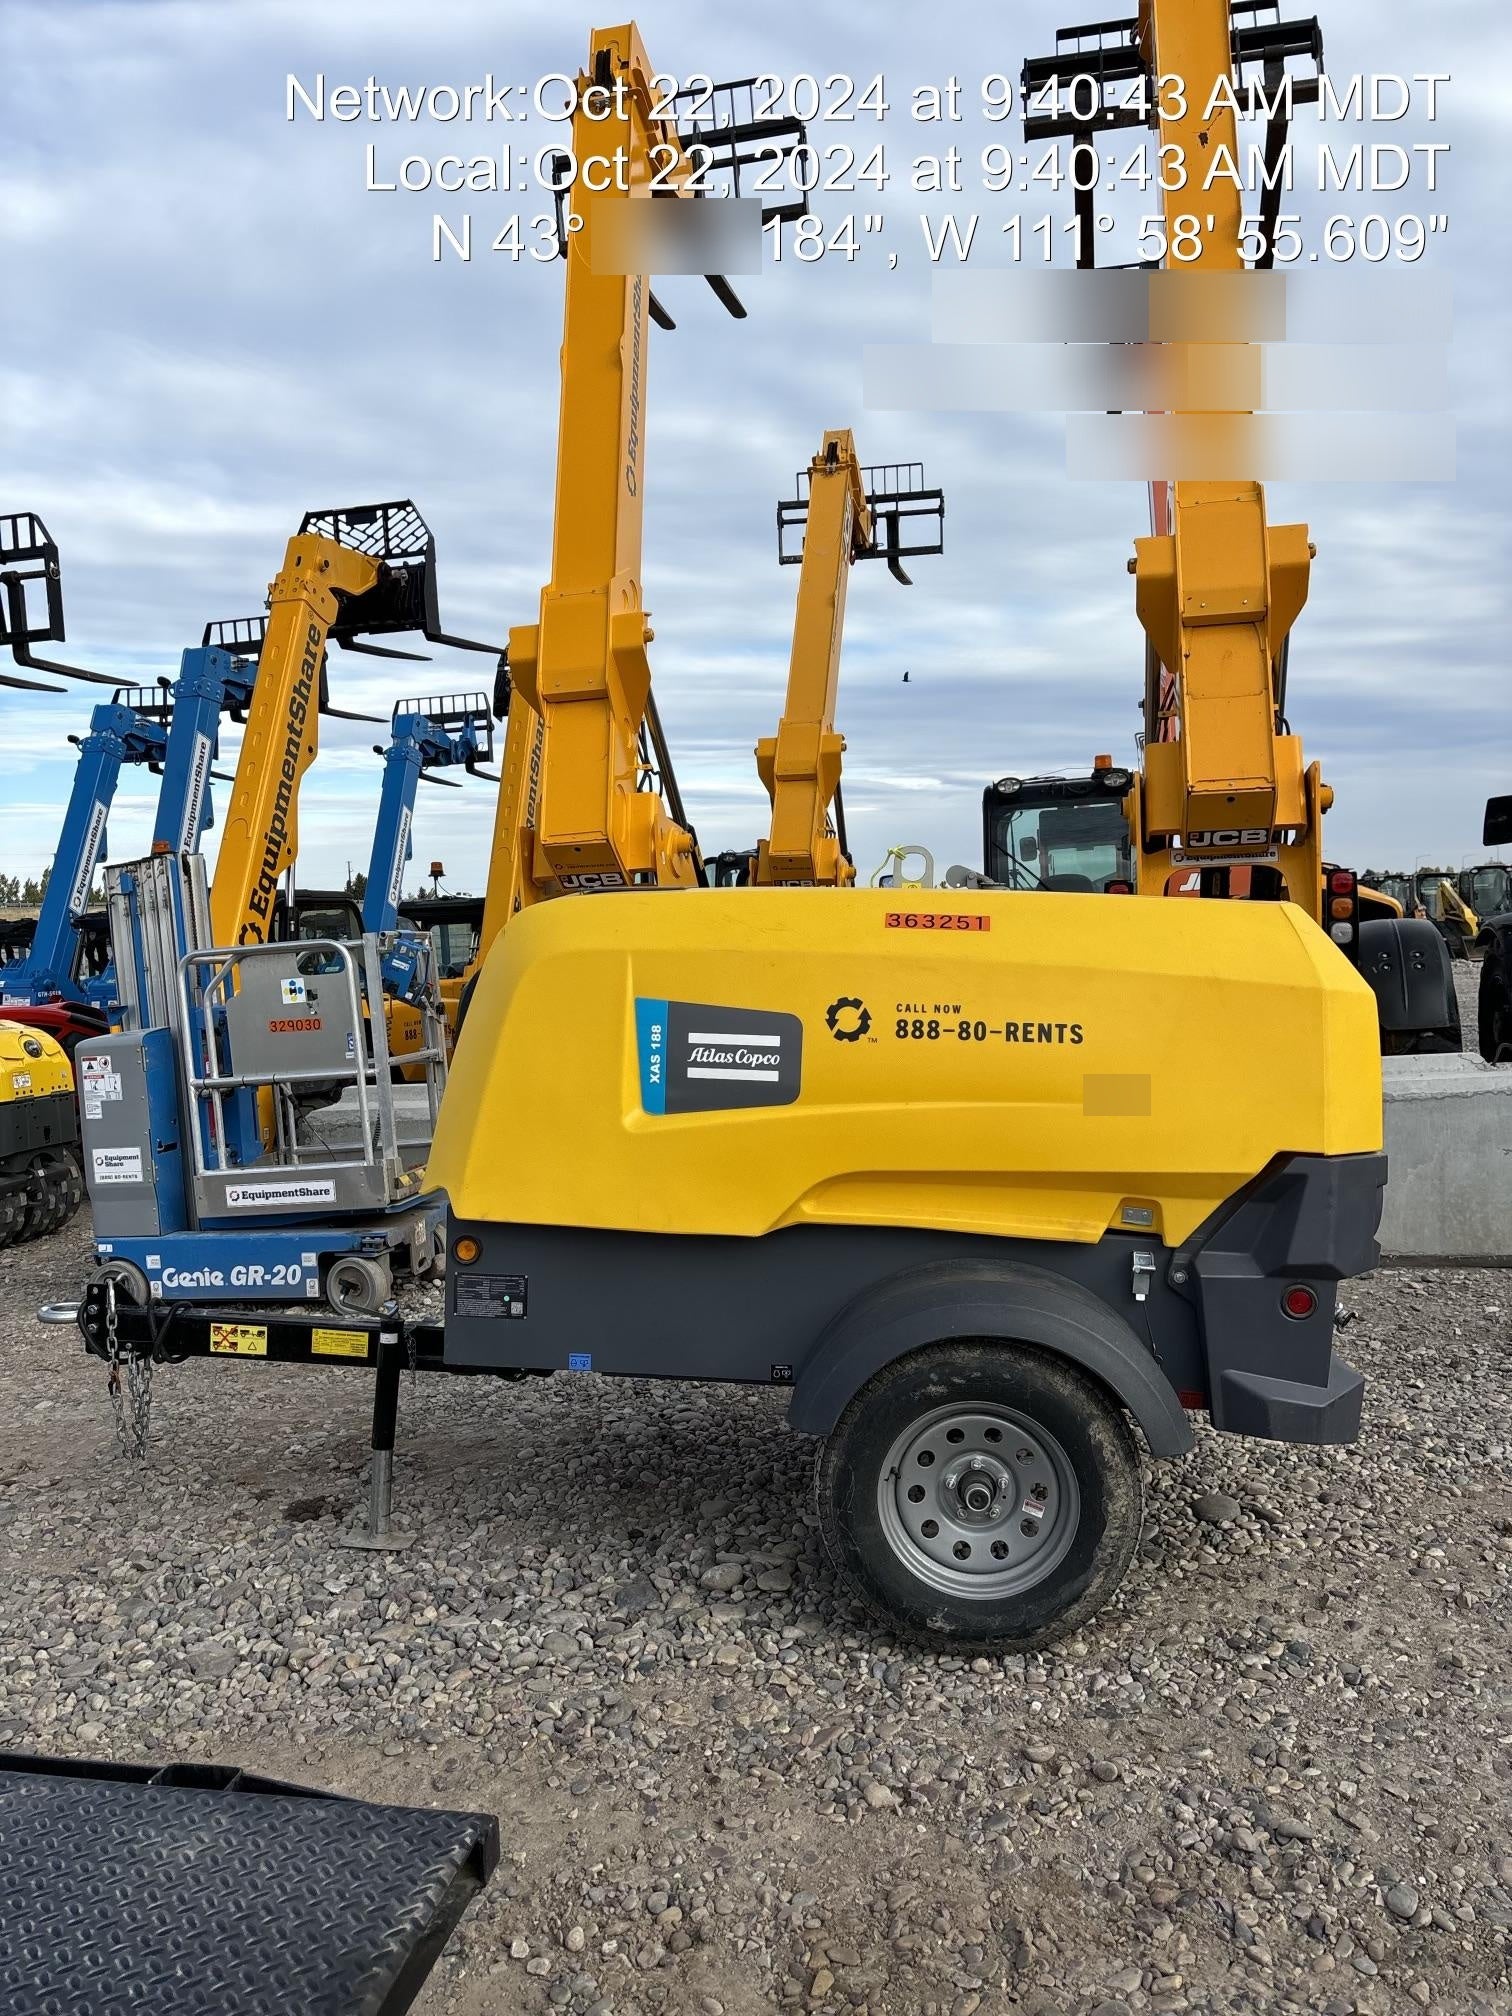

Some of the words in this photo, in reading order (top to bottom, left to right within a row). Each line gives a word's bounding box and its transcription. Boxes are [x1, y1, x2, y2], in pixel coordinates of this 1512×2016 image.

[249, 623, 322, 920] EquipmentShare
[185, 740, 207, 849] EquipmentShare
[1190, 829, 1267, 847] JCB
[77, 808, 104, 896] EquipmentShare
[562, 873, 624, 888] JCB
[888, 914, 984, 930] 363251
[896, 1003, 928, 1013] CALL
[934, 1004, 962, 1014] NOW
[270, 1019, 321, 1033] 329030
[650, 1024, 662, 1049] 188
[895, 1018, 1084, 1044] 888-80-RENTS
[687, 1047, 733, 1064] Atlas
[735, 1049, 780, 1067] Copco
[650, 1054, 661, 1084] XAS
[241, 1188, 330, 1201] EquipmentShare
[162, 1267, 224, 1288] Genie
[230, 1264, 302, 1286] GR-20
